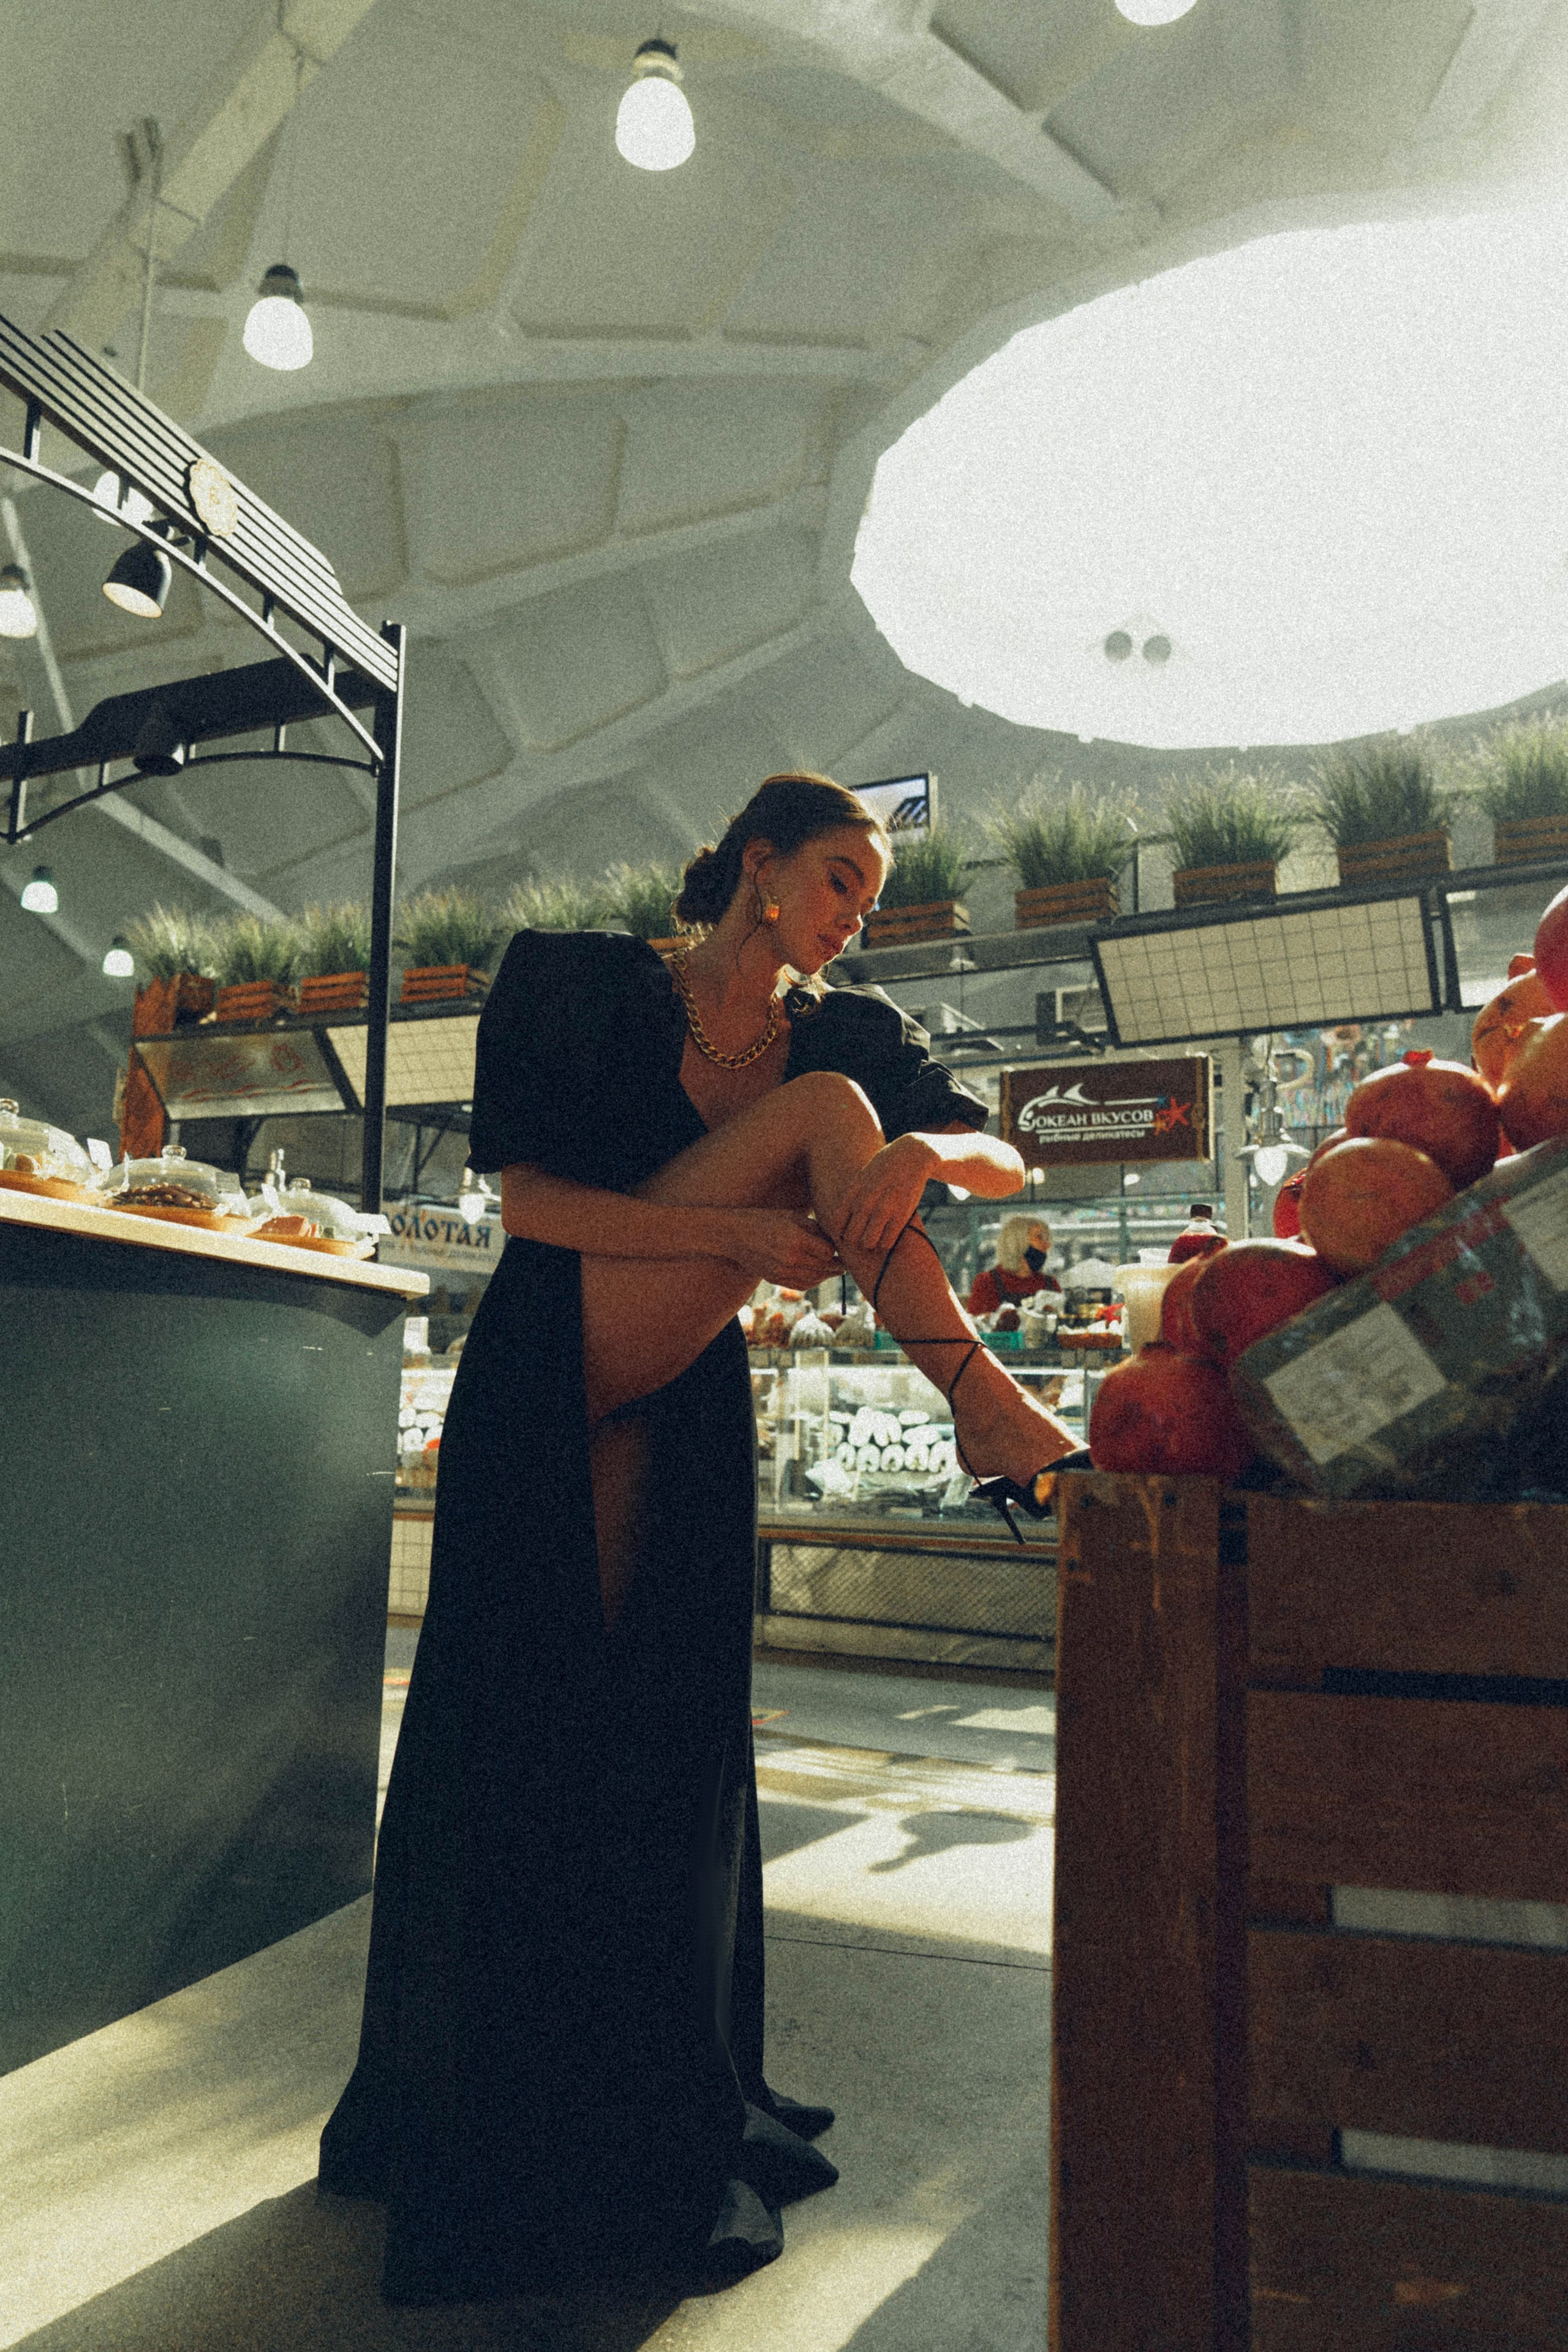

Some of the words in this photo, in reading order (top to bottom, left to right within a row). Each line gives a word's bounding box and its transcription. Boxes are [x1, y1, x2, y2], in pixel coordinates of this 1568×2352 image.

[1035, 1112, 1088, 1128] ОКЕАН
[1091, 1109, 1154, 1125] ВКУСОВ
[383, 1212, 491, 1248] ОЛОТАЯ
